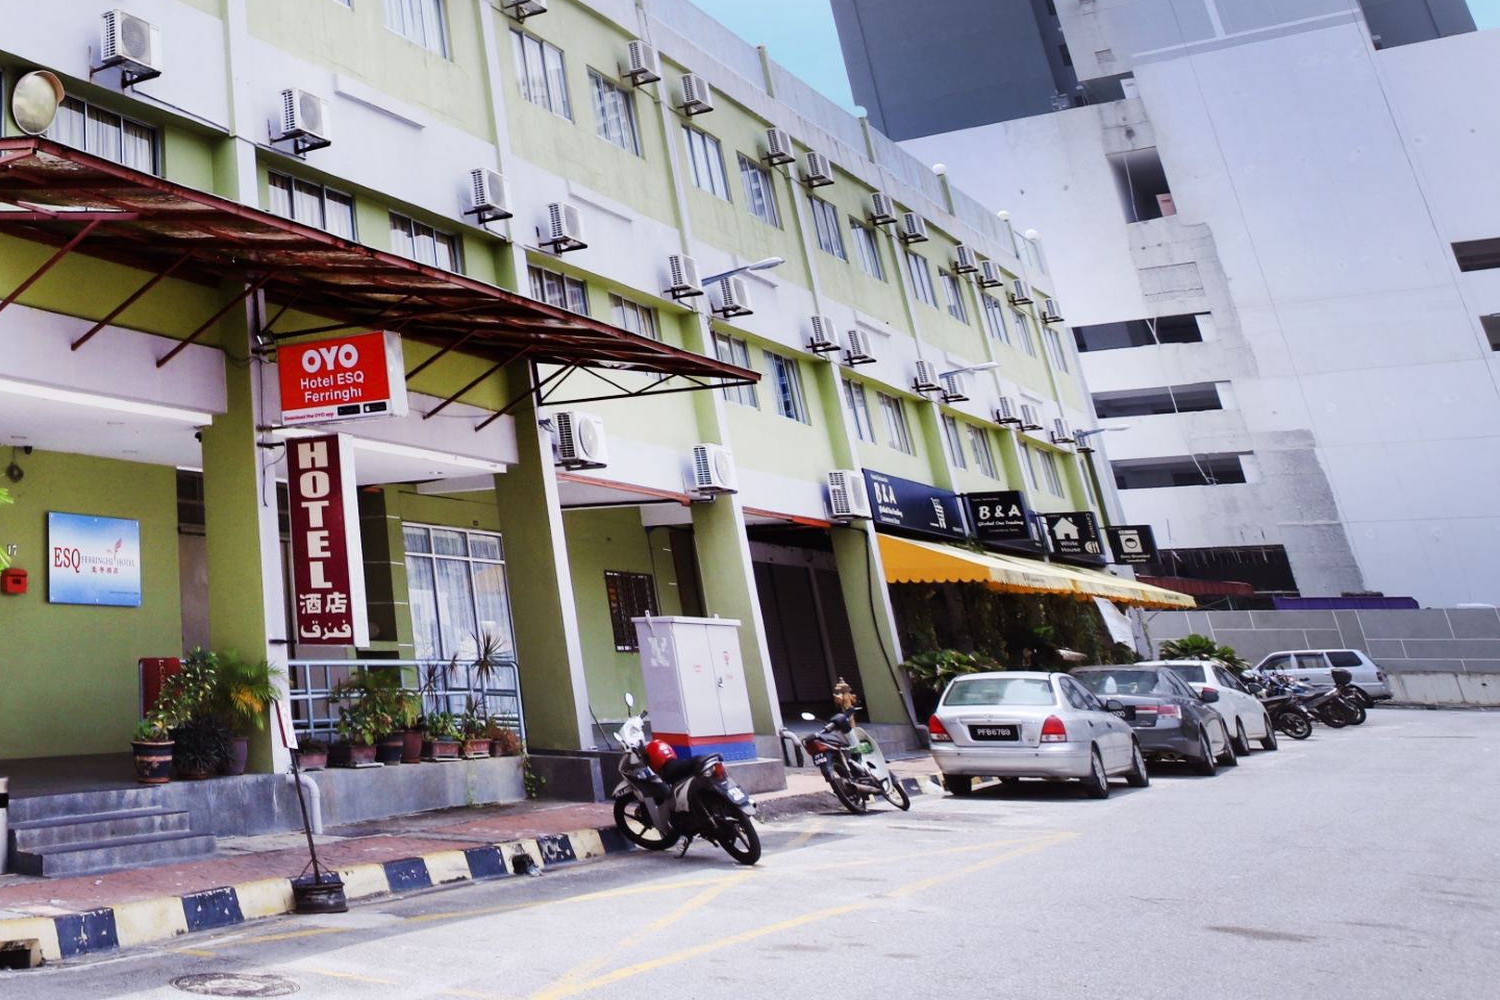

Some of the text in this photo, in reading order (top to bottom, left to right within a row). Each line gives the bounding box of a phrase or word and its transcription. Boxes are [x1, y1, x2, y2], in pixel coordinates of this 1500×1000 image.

[302, 343, 359, 373] OYO
[300, 370, 364, 389] Hotel ESQ
[304, 386, 362, 403] Ferringhi
[297, 441, 332, 589] HOTEL
[53, 547, 81, 573] ESQ
[299, 591, 347, 614] 酒店
